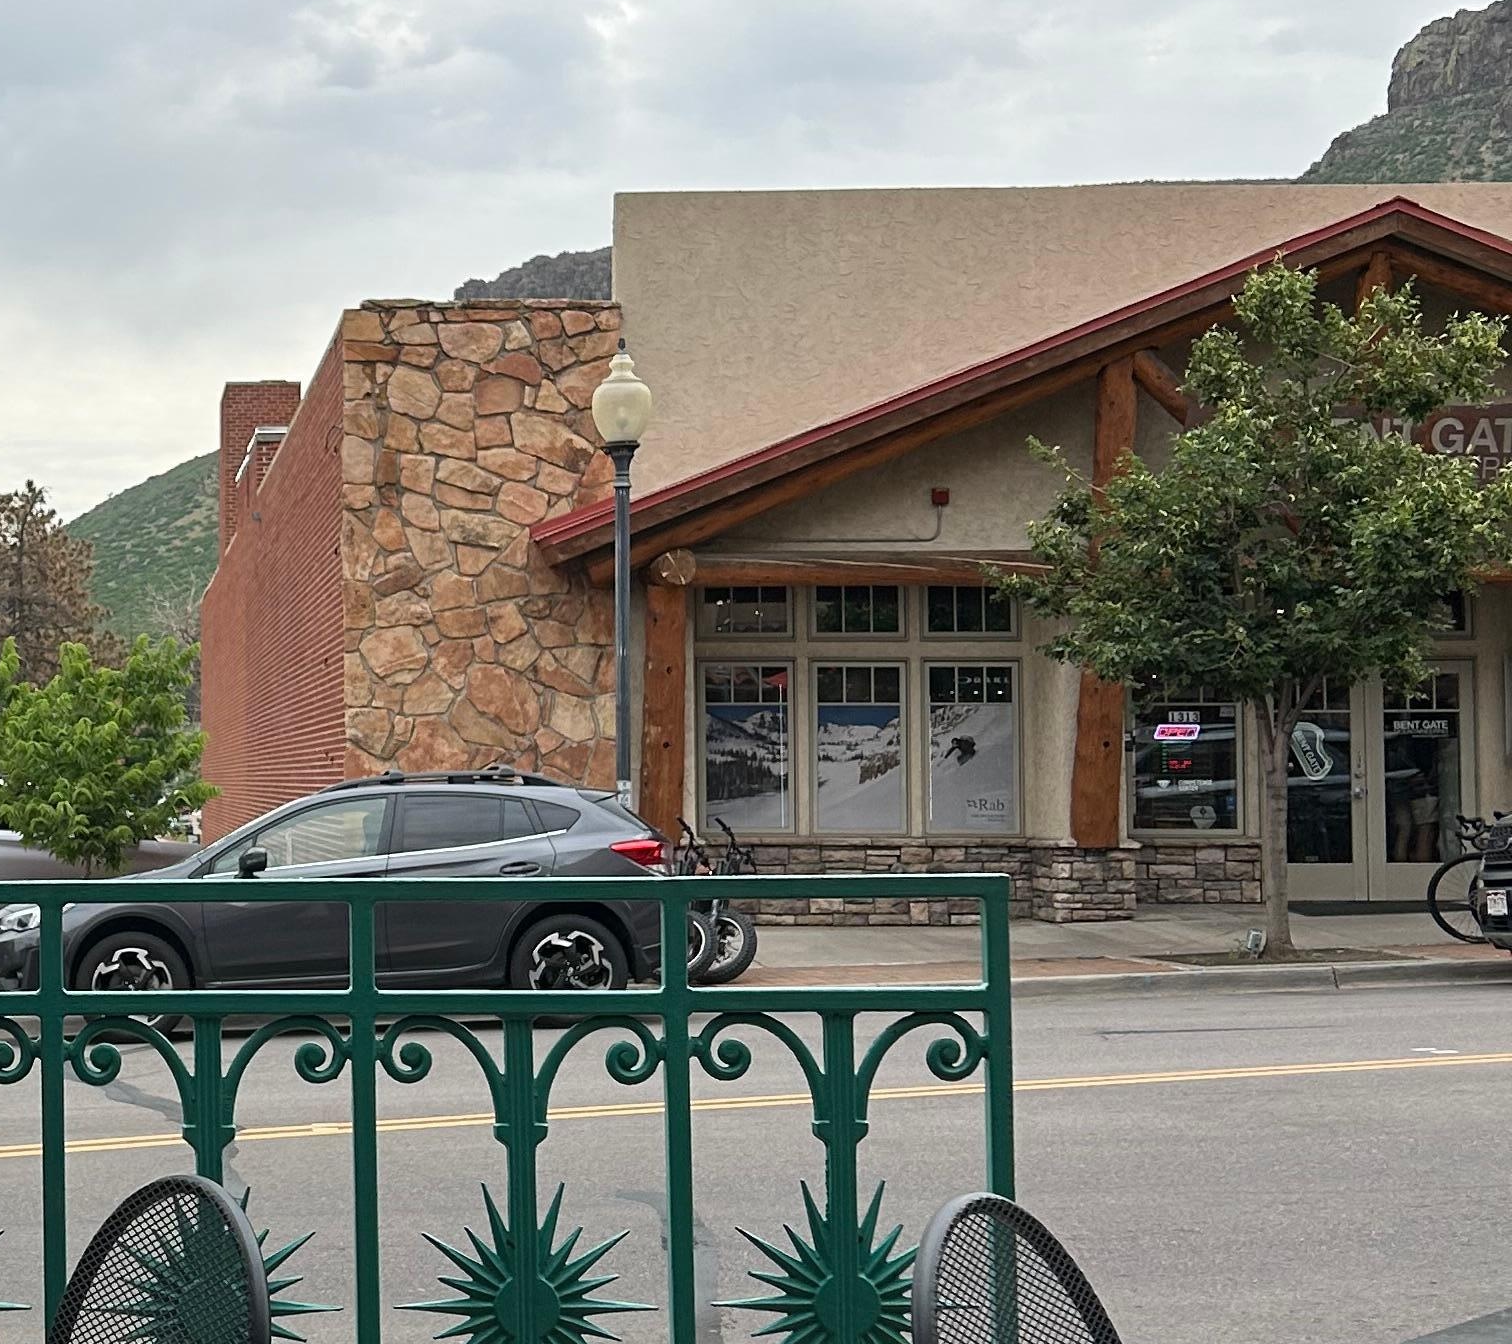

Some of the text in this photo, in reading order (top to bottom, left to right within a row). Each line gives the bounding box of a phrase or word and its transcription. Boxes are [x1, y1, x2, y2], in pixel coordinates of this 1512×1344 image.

[1431, 417, 1512, 453] GAT
[1170, 712, 1200, 722] 1313
[1393, 720, 1449, 730] BENT GATE
[978, 798, 1005, 812] Rab
